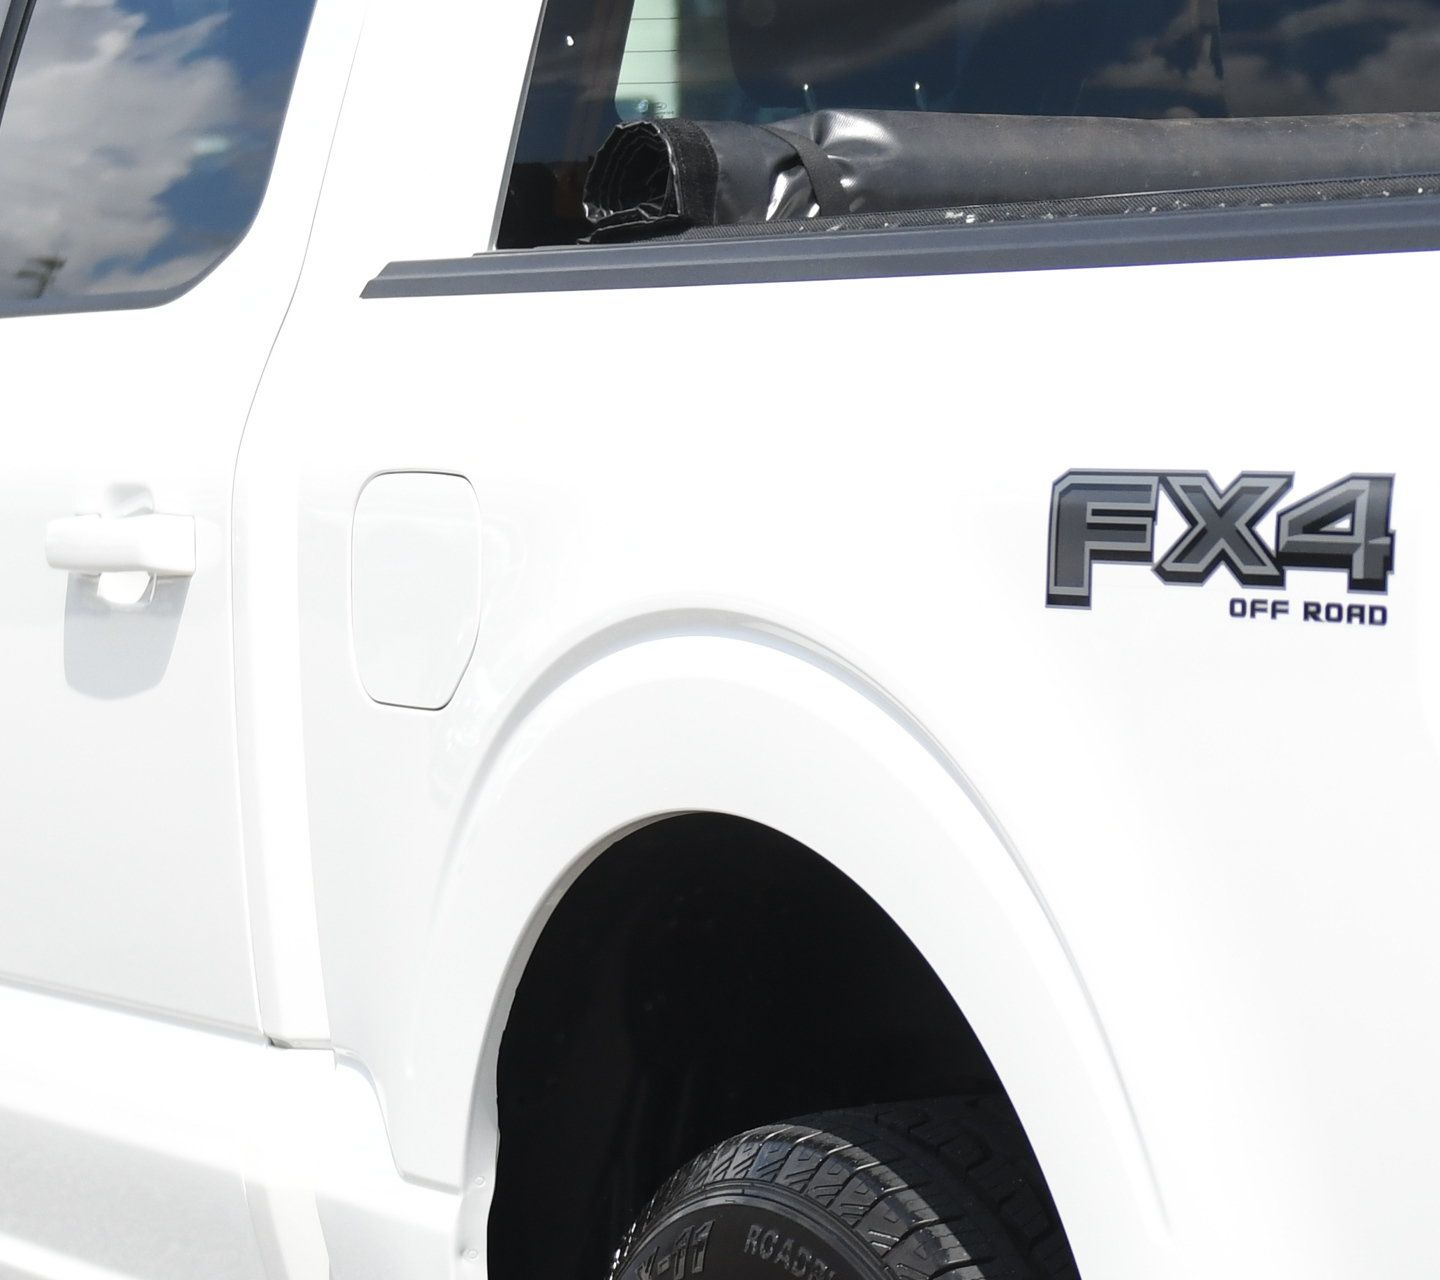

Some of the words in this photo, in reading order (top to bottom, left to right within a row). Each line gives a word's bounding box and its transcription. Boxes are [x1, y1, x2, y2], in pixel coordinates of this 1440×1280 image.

[1045, 468, 1396, 610] FX4
[1228, 597, 1290, 620] OFF
[1302, 600, 1389, 627] ROAD
